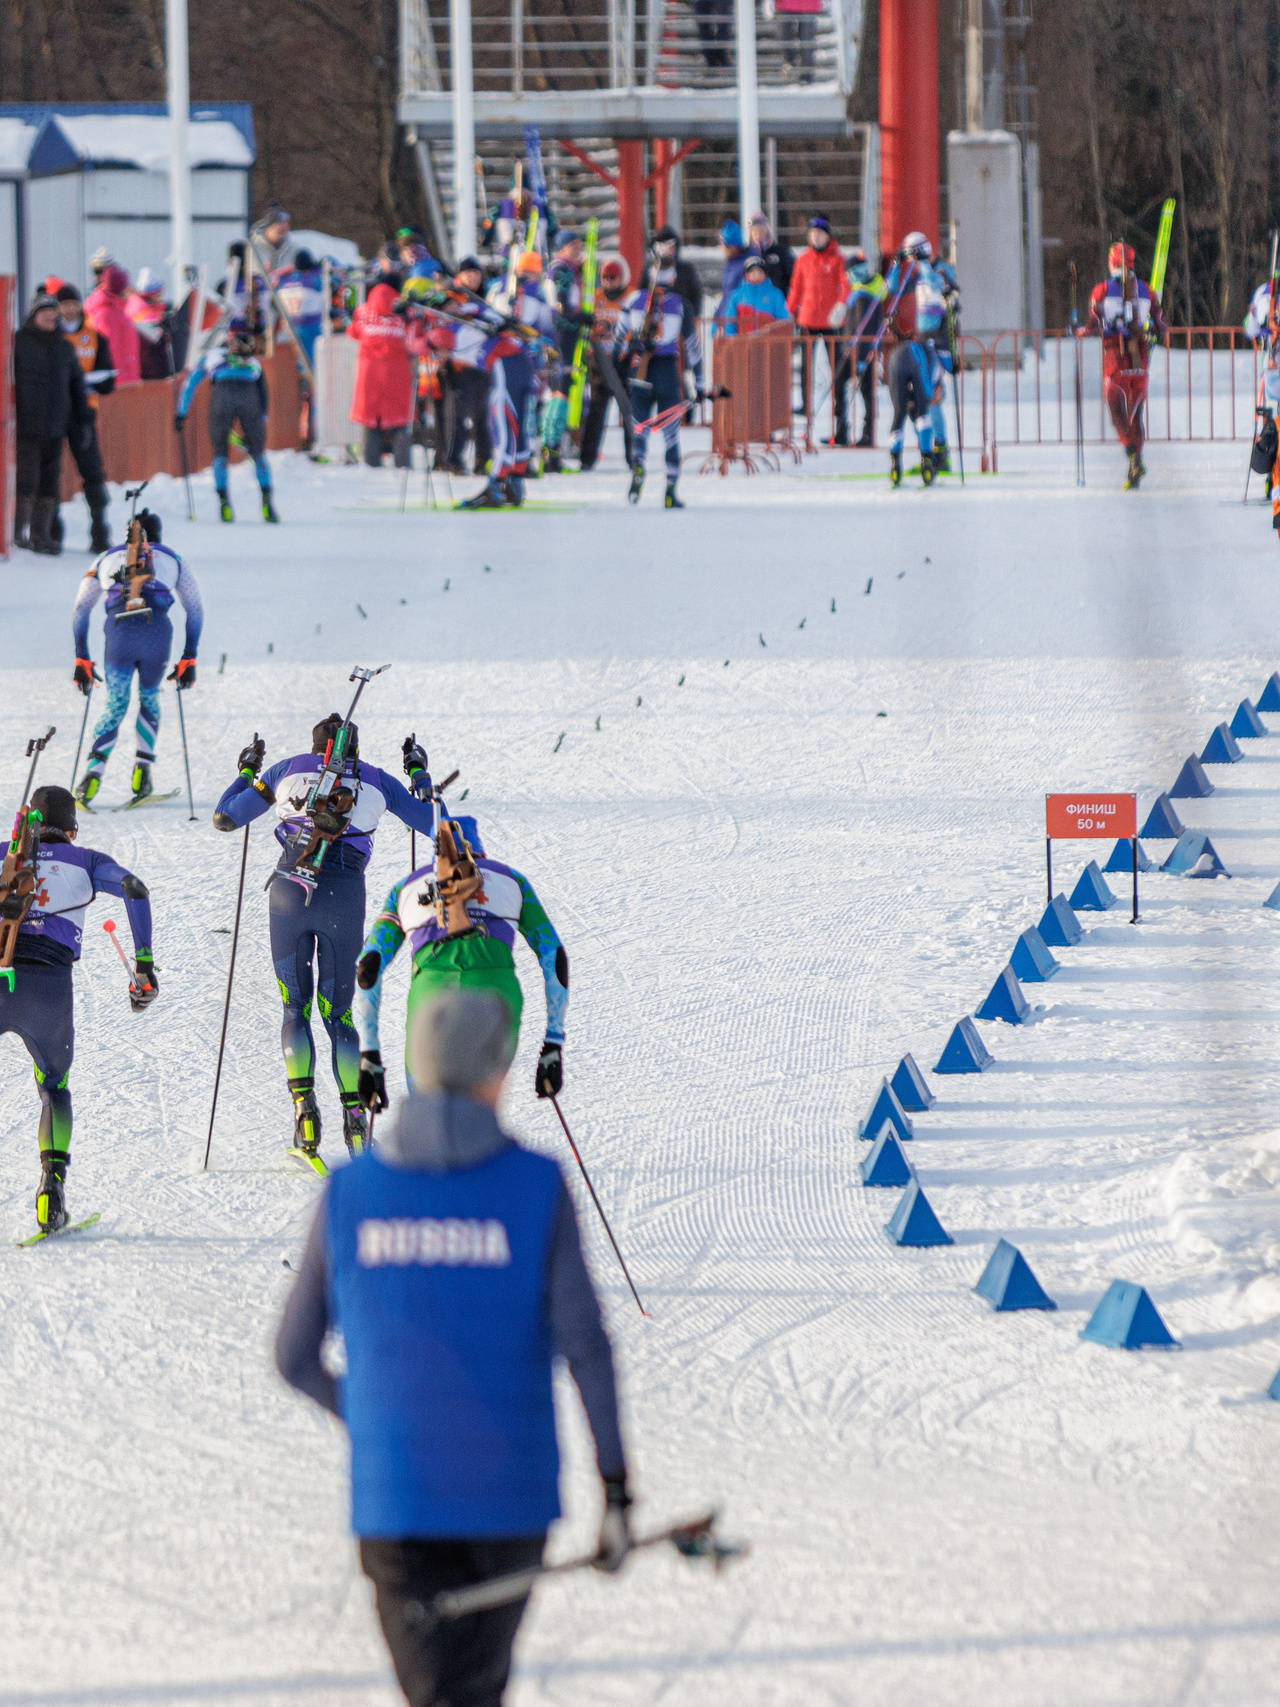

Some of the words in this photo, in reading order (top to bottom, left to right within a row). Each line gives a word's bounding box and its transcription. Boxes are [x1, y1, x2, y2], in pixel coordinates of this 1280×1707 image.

[1066, 804, 1116, 814] ФИНИШ
[1077, 819, 1093, 829] 50
[1096, 821, 1105, 829] м
[358, 1217, 511, 1267] RUSSIA
